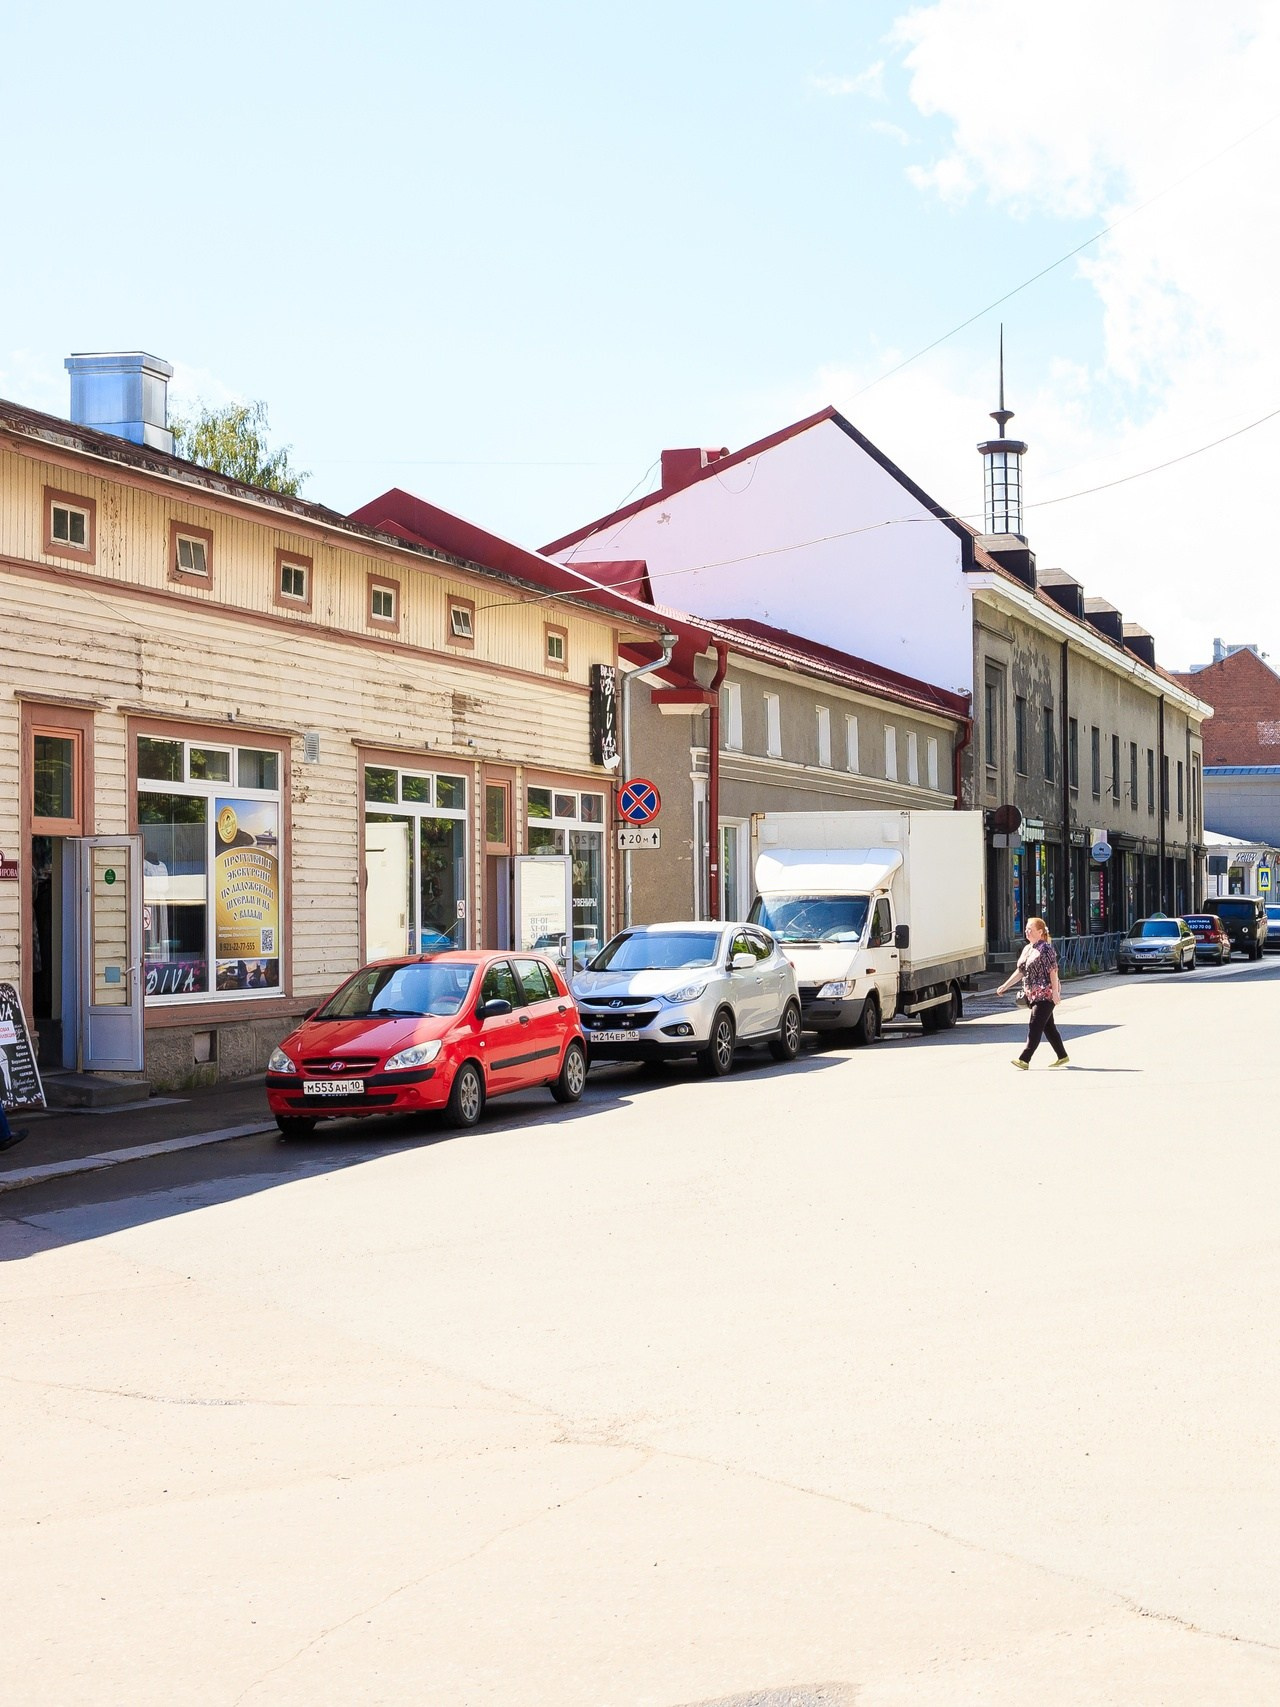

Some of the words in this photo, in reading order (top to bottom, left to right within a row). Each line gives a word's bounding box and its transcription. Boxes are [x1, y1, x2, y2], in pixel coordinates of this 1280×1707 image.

[629, 834, 641, 844] 20
[146, 968, 195, 995] DIVA
[307, 1083, 348, 1093] М553АН
[350, 1081, 360, 1089] 10
